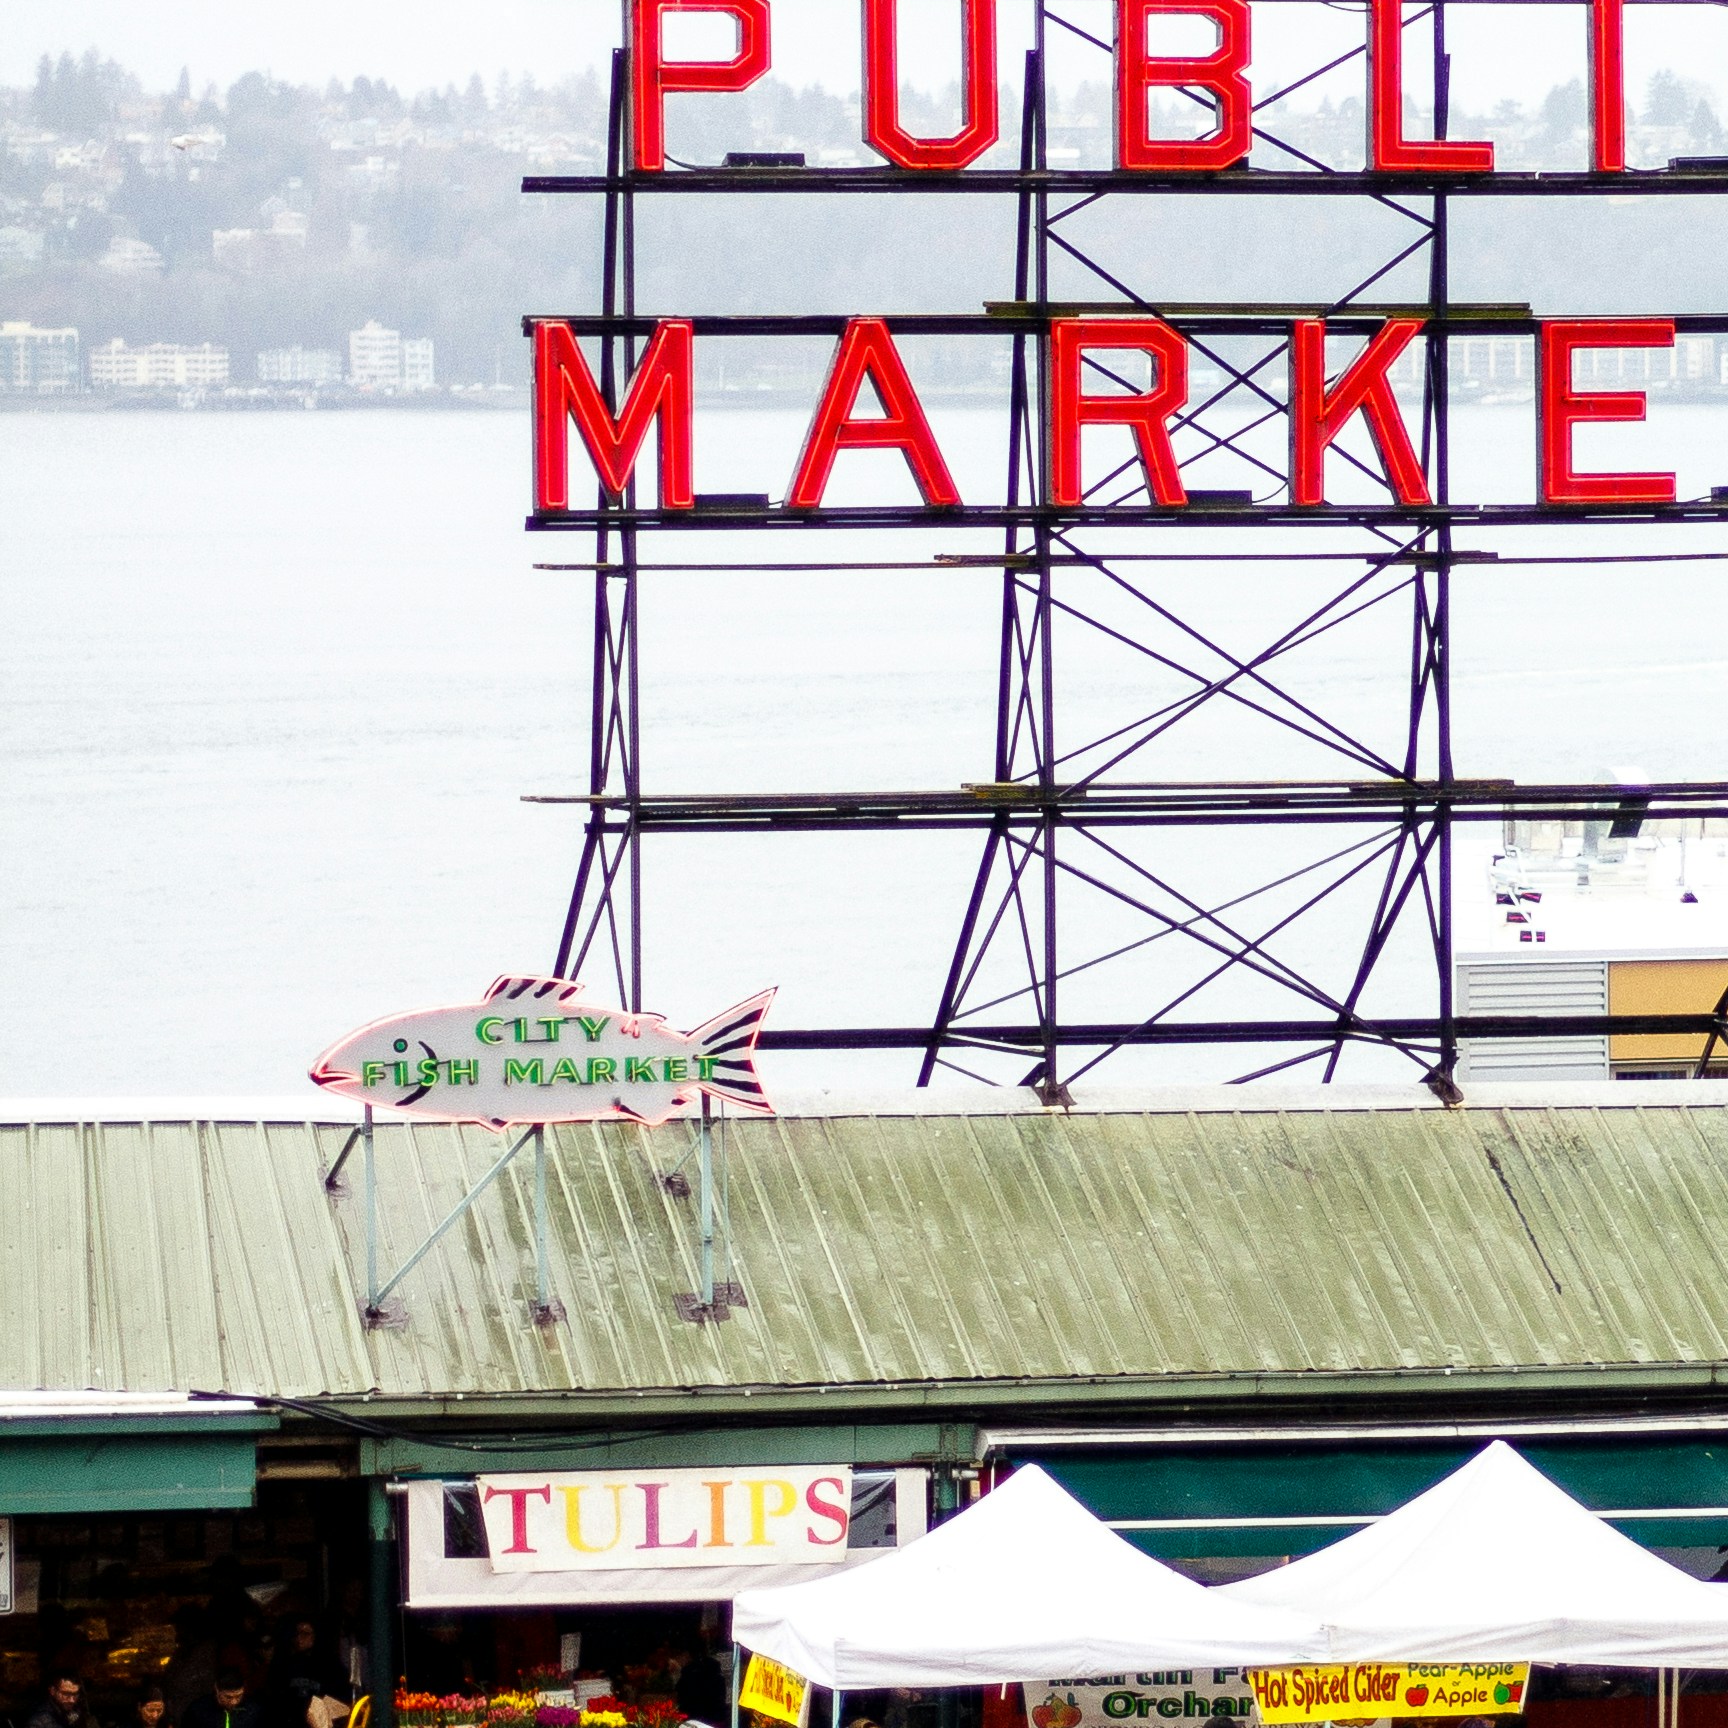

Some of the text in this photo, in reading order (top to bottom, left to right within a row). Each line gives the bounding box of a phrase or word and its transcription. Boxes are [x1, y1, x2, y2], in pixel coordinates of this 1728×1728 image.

[475, 1015, 611, 1047] CITY
[362, 1054, 720, 1087] FISH MARKET
[484, 1477, 848, 1554] TULIPS
[1408, 1662, 1514, 1679] Pear-Apple
[1253, 1664, 1401, 1714] Hot Spiced Cider
[1433, 1688, 1488, 1707] Apple
